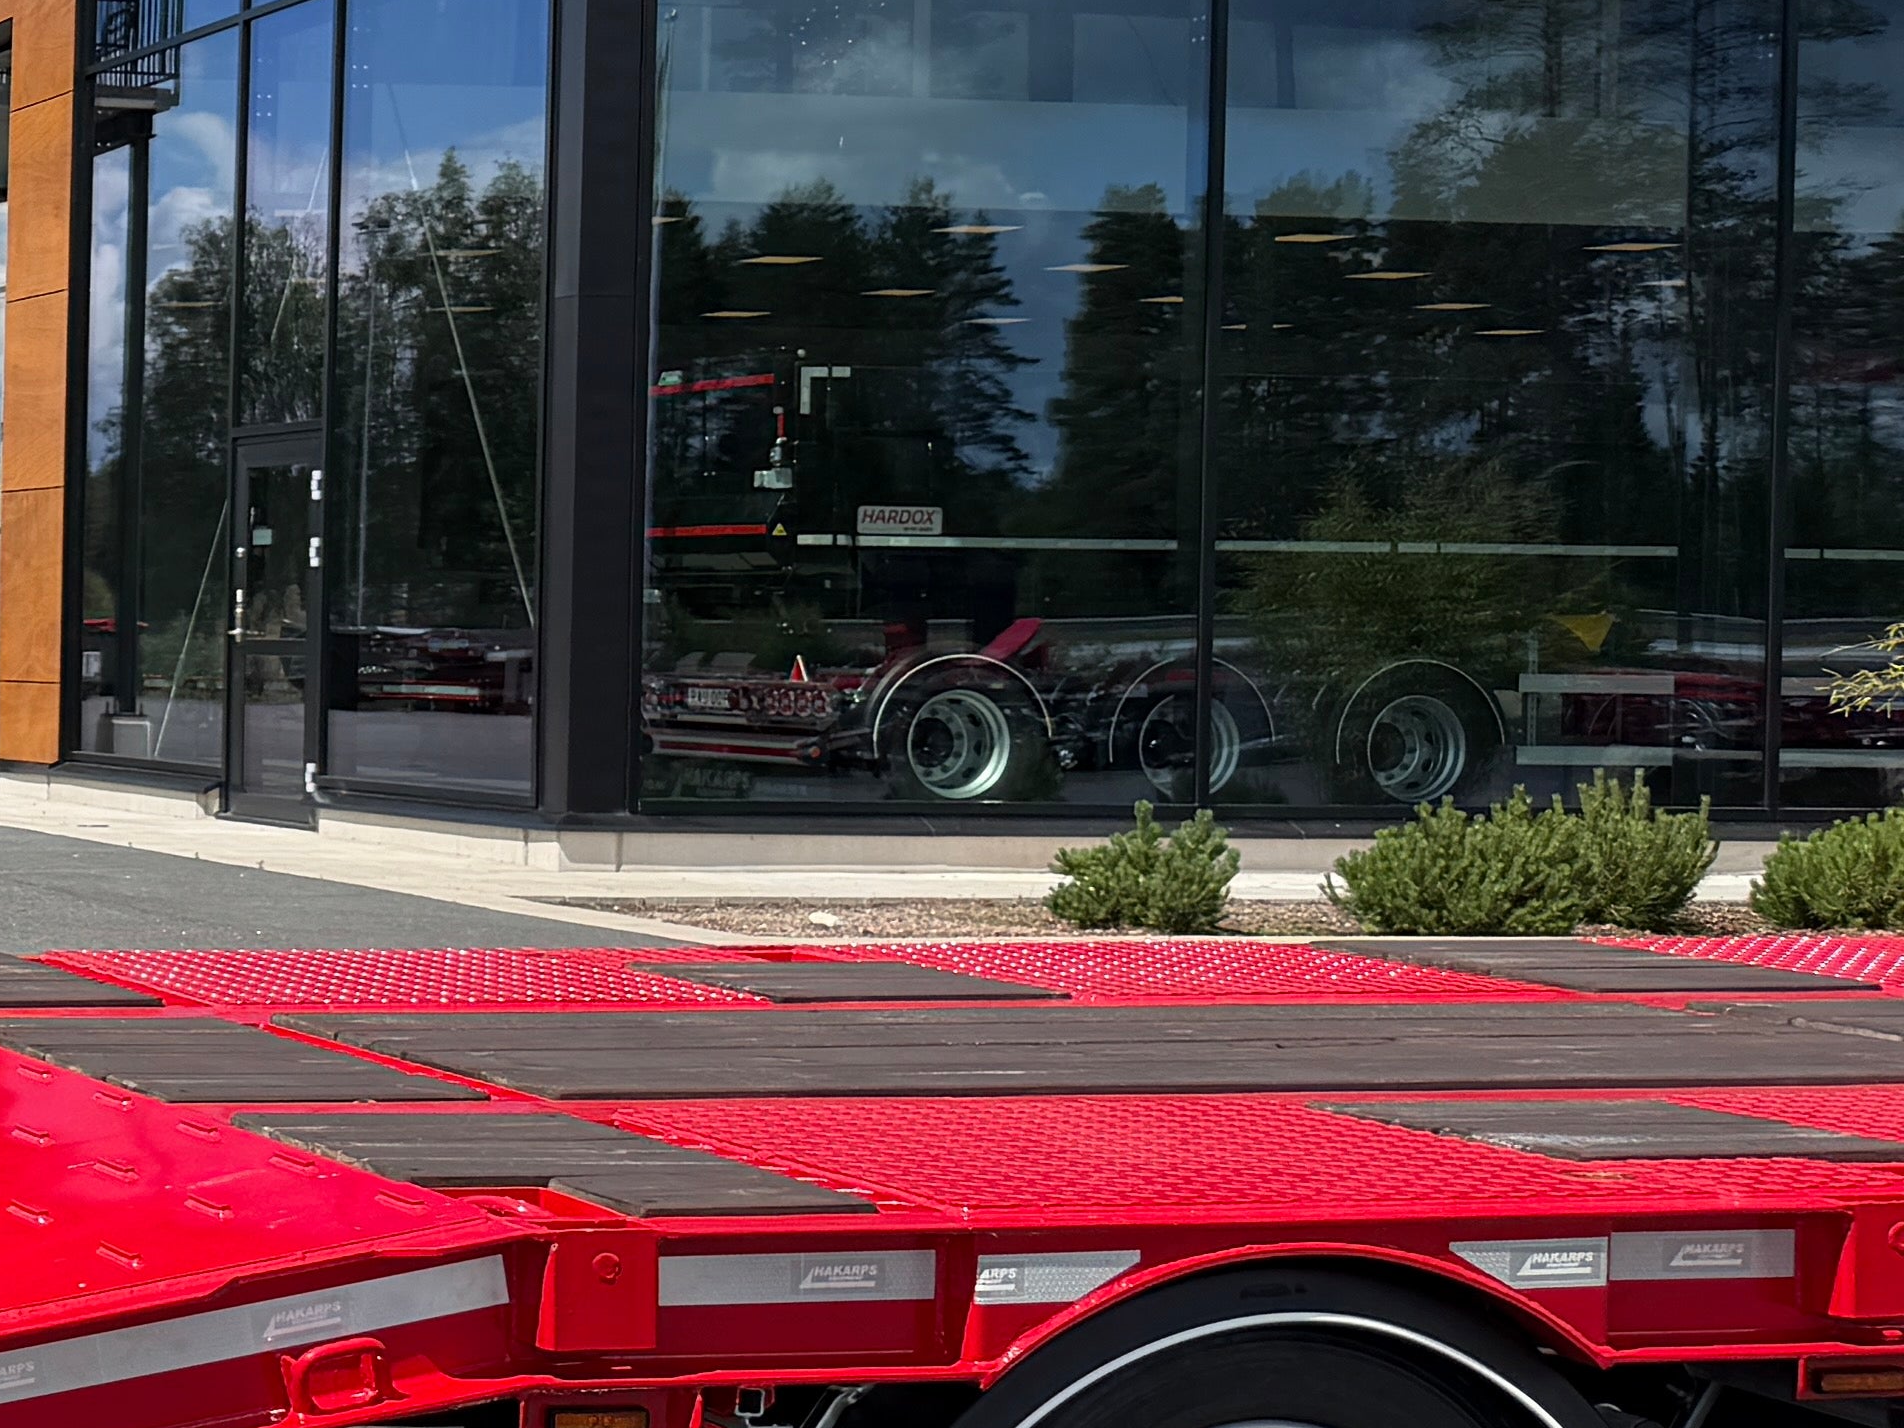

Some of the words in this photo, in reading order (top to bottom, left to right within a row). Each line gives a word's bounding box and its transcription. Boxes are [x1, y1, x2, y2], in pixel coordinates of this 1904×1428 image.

[861, 509, 936, 525] HARDOX
[1532, 1251, 1594, 1264] HAKARPS
[814, 1264, 878, 1277] HAKARPS
[276, 1300, 341, 1323] HAKARPS
